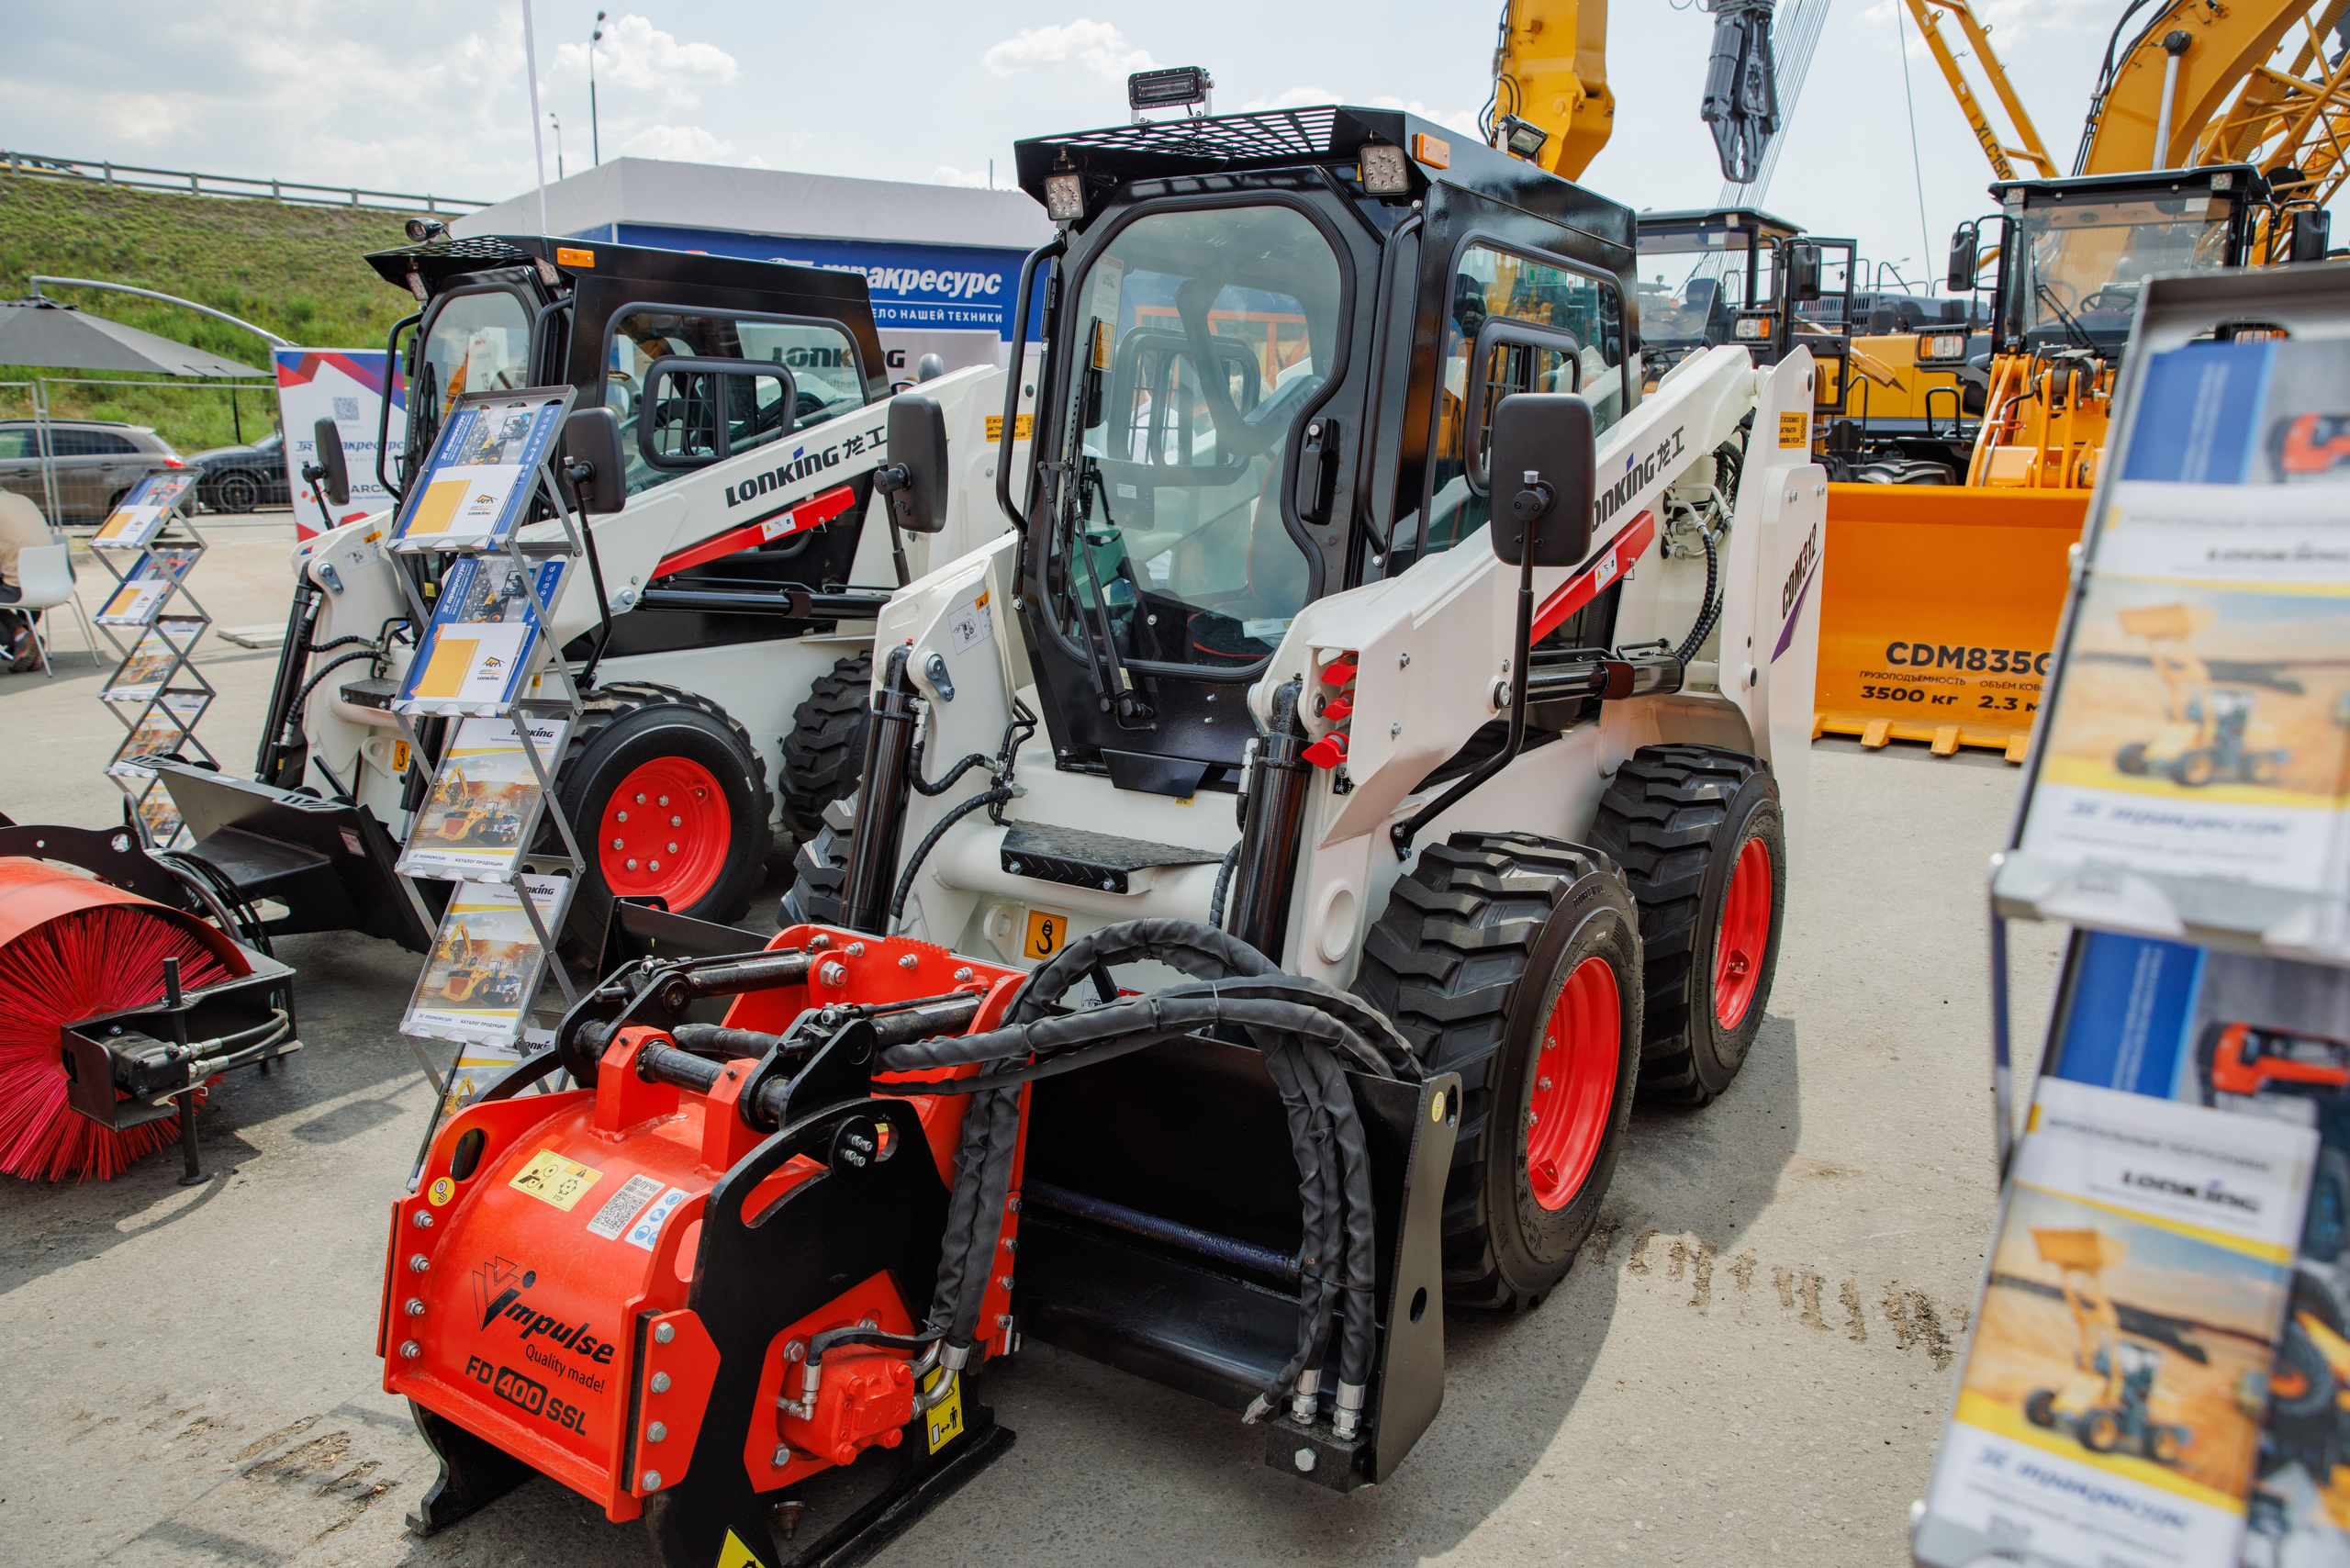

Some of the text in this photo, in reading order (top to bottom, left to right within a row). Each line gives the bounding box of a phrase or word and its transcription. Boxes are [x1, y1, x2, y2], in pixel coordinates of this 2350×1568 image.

[901, 308, 945, 321] НАШЕЙ
[947, 310, 1003, 323] ТЕХНИКИ
[724, 445, 841, 509] LONKING
[1591, 451, 1655, 533] ONKING
[1782, 521, 1817, 621] CDM312
[1860, 670, 1966, 686] ГРУЗОПОДЪЁМНОСТЬ
[1860, 685, 1959, 705] 3500 кг
[1980, 679, 2017, 690] ОБЪЁМ
[1977, 695, 2019, 711] 2.3
[525, 1343, 606, 1394] Quality made!
[464, 1354, 587, 1437] FD 400 SSL
